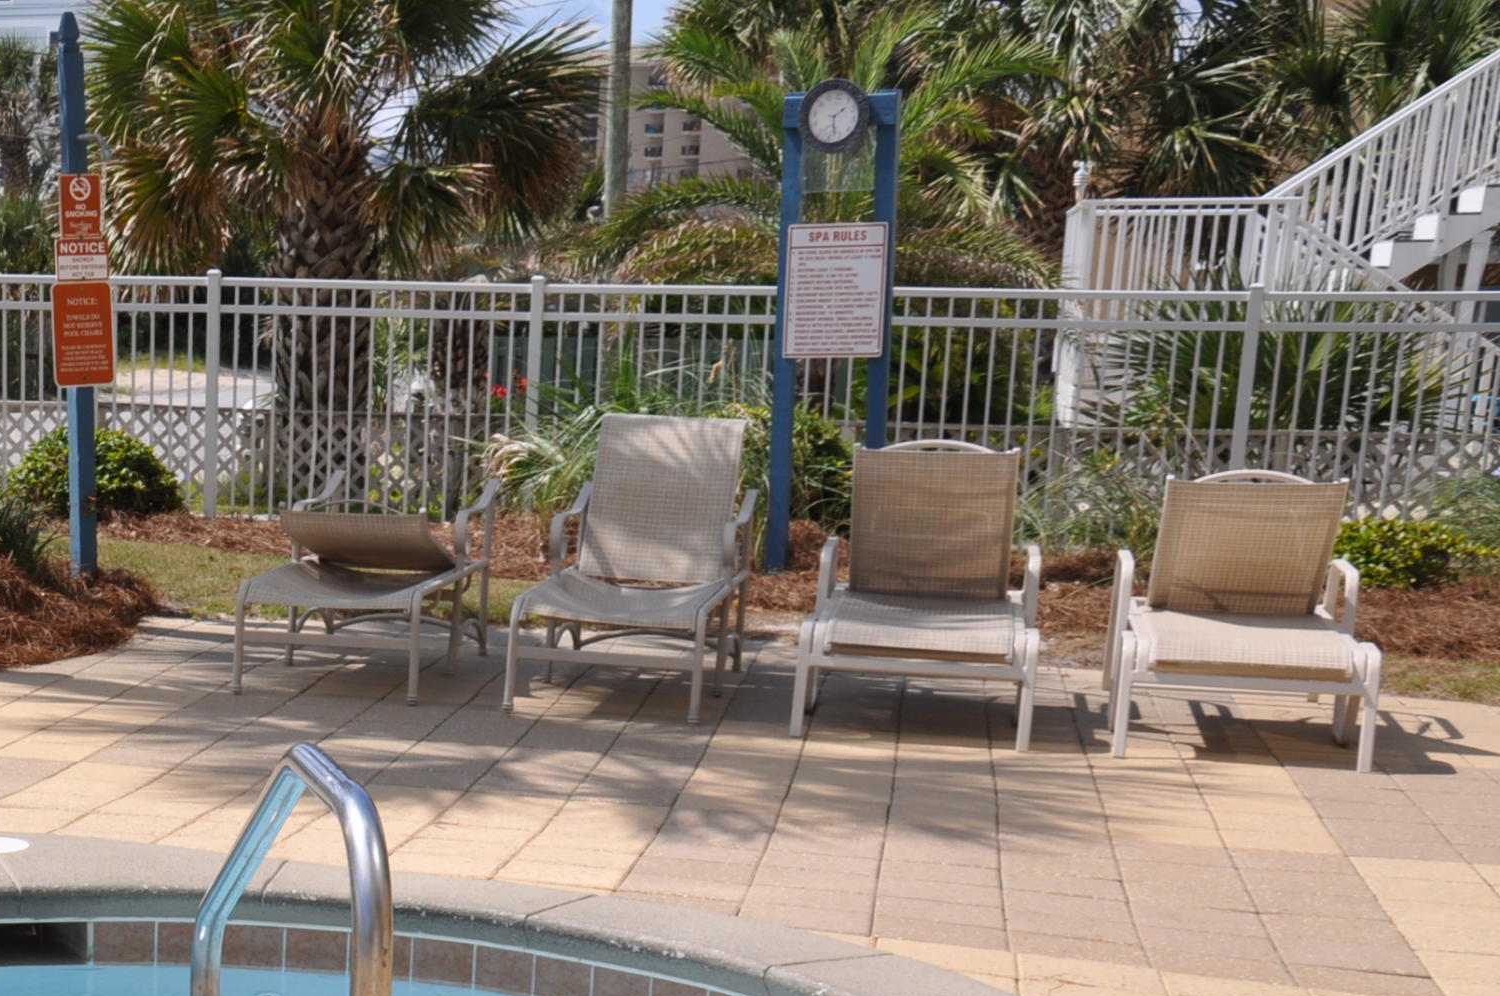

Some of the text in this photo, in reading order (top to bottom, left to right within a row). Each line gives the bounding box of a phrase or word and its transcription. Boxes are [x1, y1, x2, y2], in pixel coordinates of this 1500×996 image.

[65, 210, 98, 218] SMOKING
[808, 230, 867, 242] SPA RULES
[59, 241, 106, 254] NOTICE
